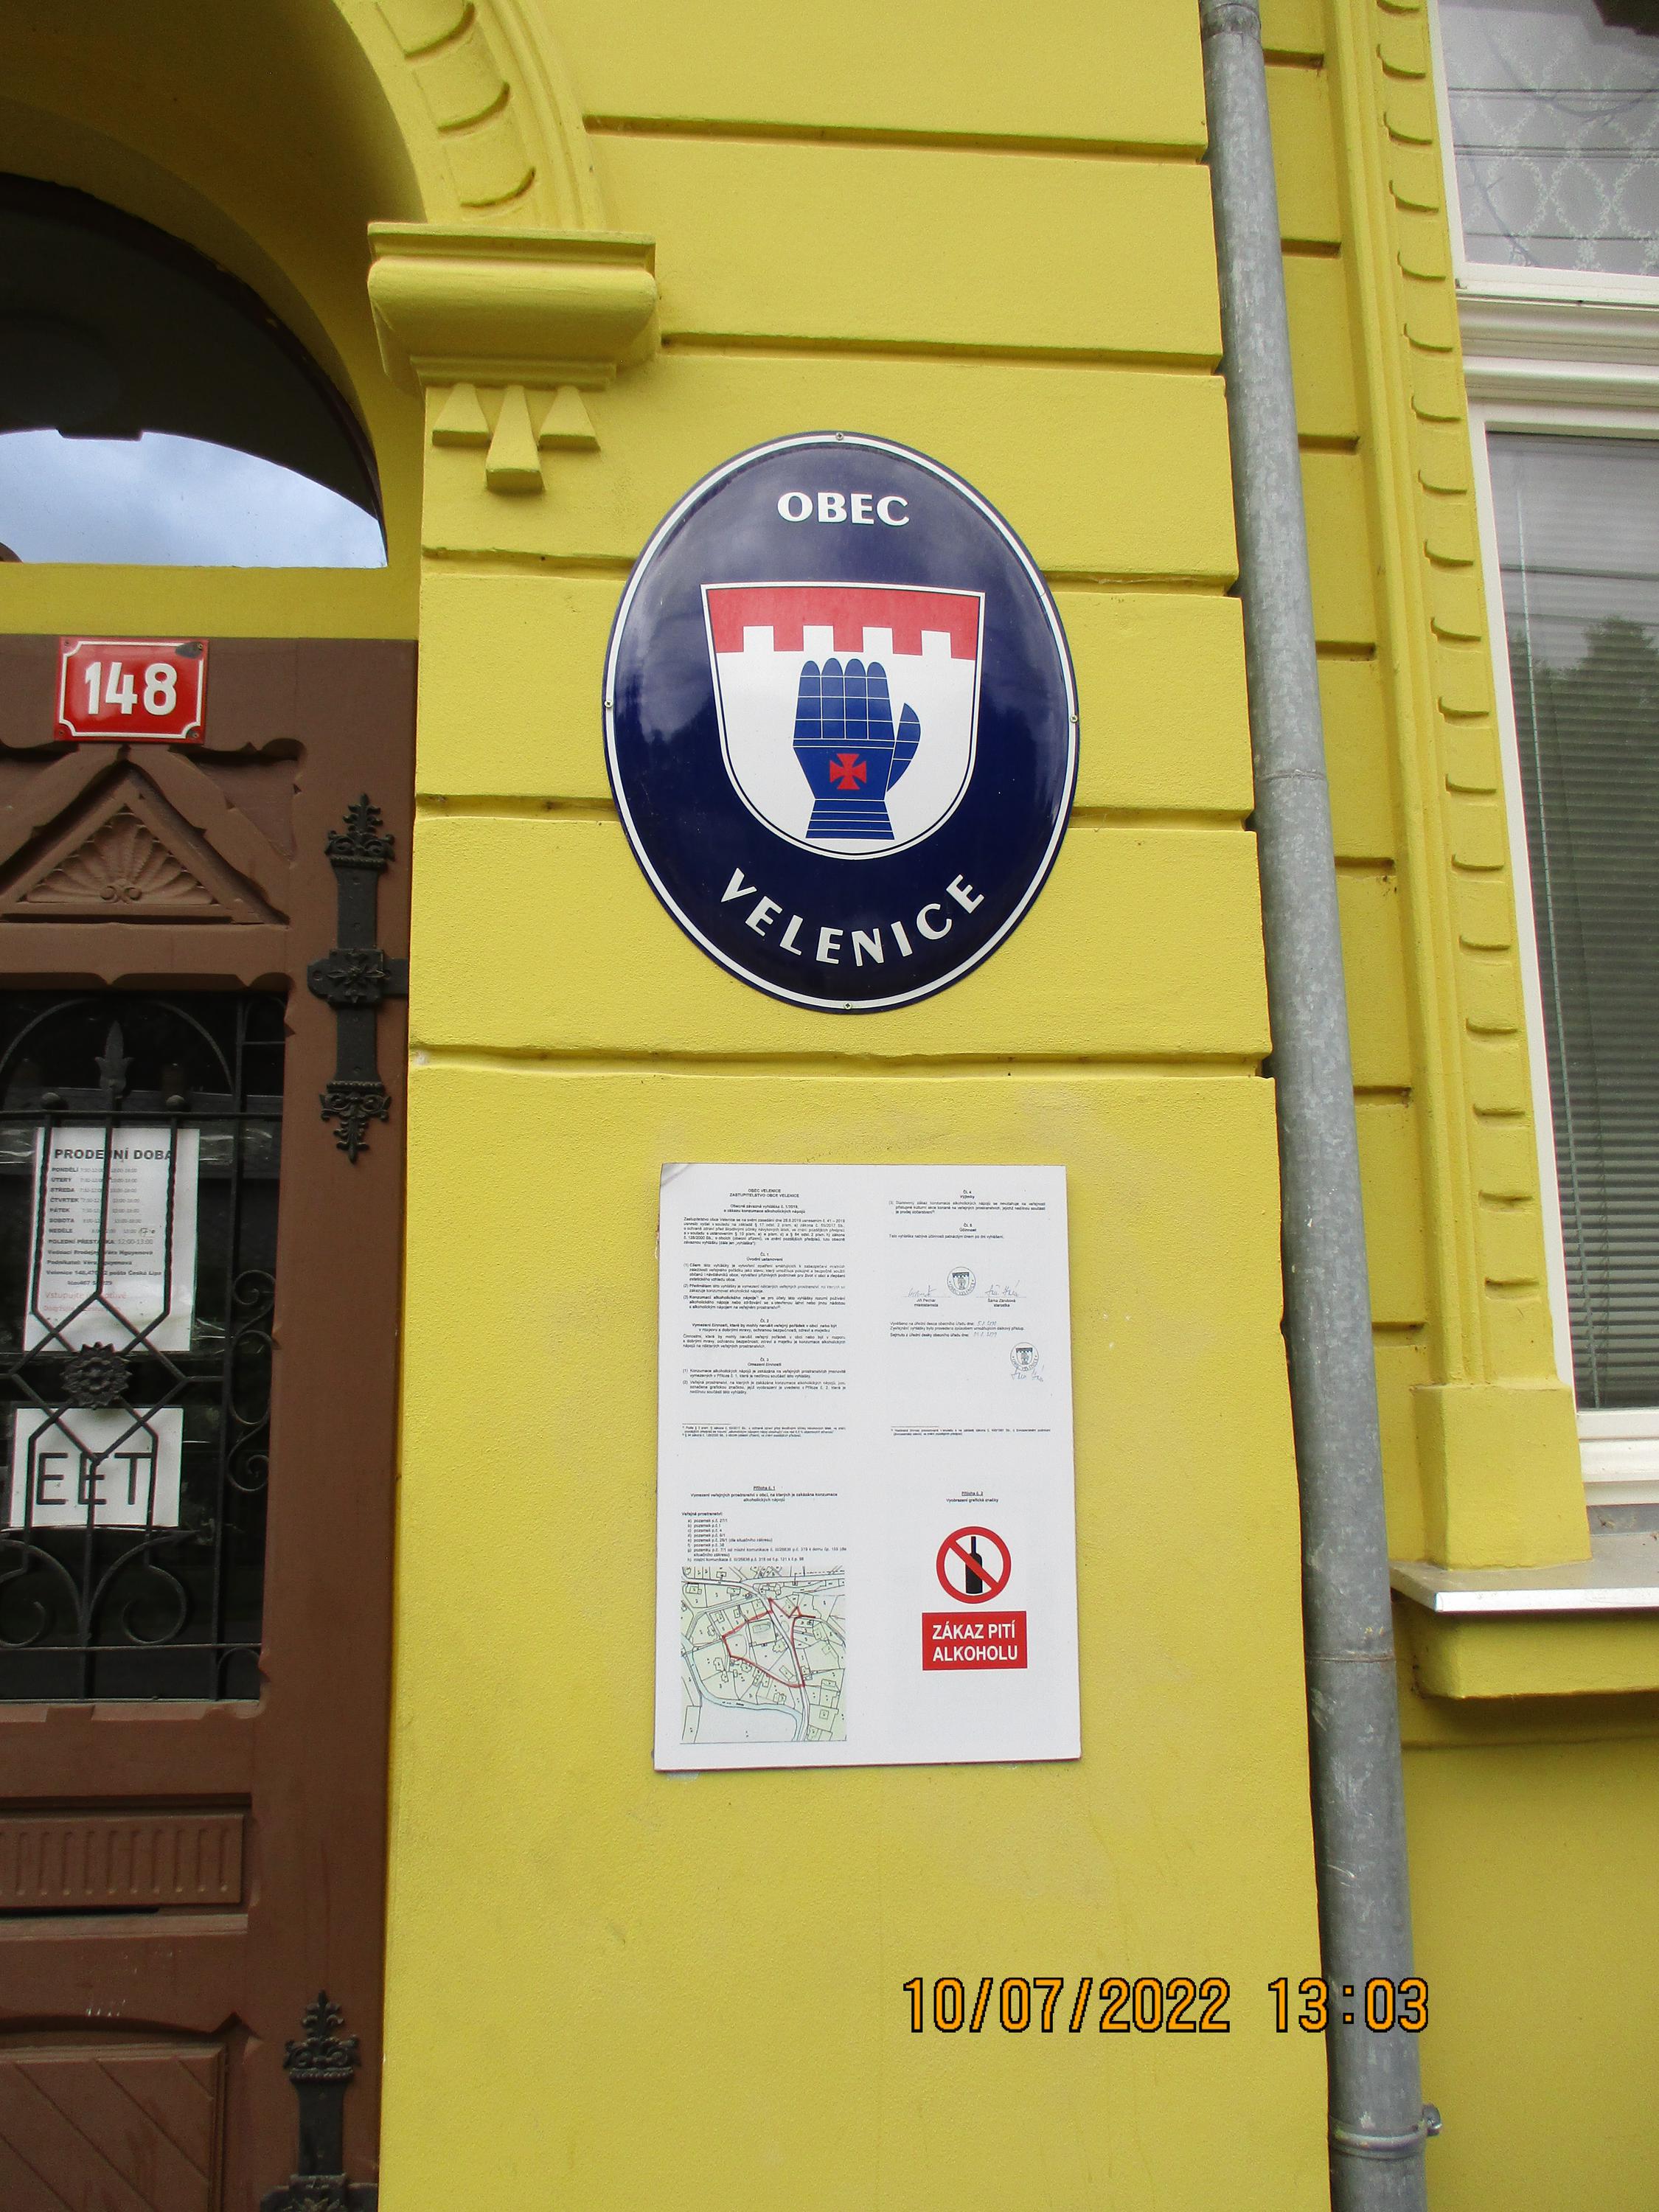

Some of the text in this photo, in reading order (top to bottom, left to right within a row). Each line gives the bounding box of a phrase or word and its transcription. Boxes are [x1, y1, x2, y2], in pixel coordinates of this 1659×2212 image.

[777, 492, 910, 526] OBEC
[85, 661, 177, 715] 148
[720, 868, 984, 967] VELENICE
[55, 1148, 129, 1160] PRODENÍ
[37, 1453, 153, 1505] EET
[932, 1620, 1015, 1640] ZÁKAZ PITÍ
[932, 1645, 1018, 1662] ALKOHOLU
